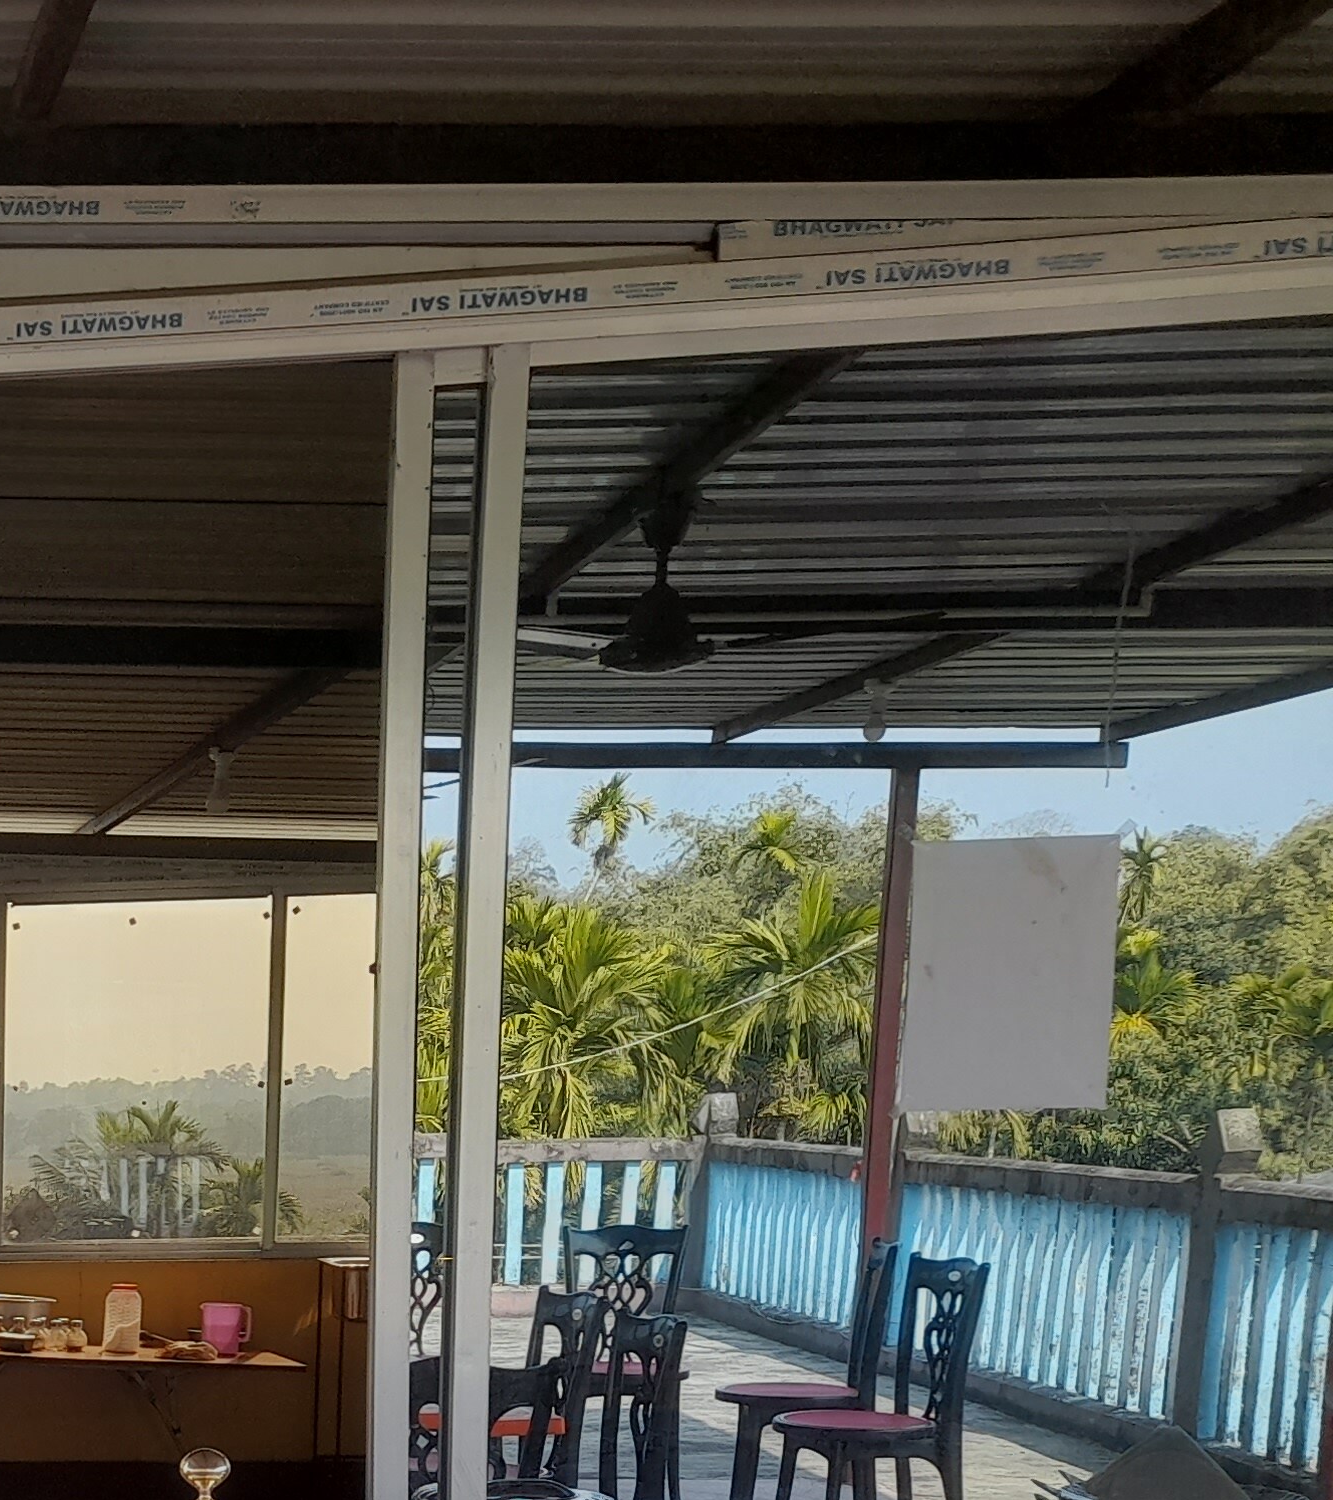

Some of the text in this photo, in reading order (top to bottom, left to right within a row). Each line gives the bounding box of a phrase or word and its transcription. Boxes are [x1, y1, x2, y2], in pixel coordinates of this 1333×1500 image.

[1262, 236, 1308, 256] SAI
[825, 267, 867, 287] SAI
[875, 258, 1011, 284] BHAGWATI
[411, 295, 451, 313] SAI
[459, 286, 588, 310] BHAGWATI
[15, 320, 53, 338] SAI
[61, 311, 183, 335] BHAGWATI
